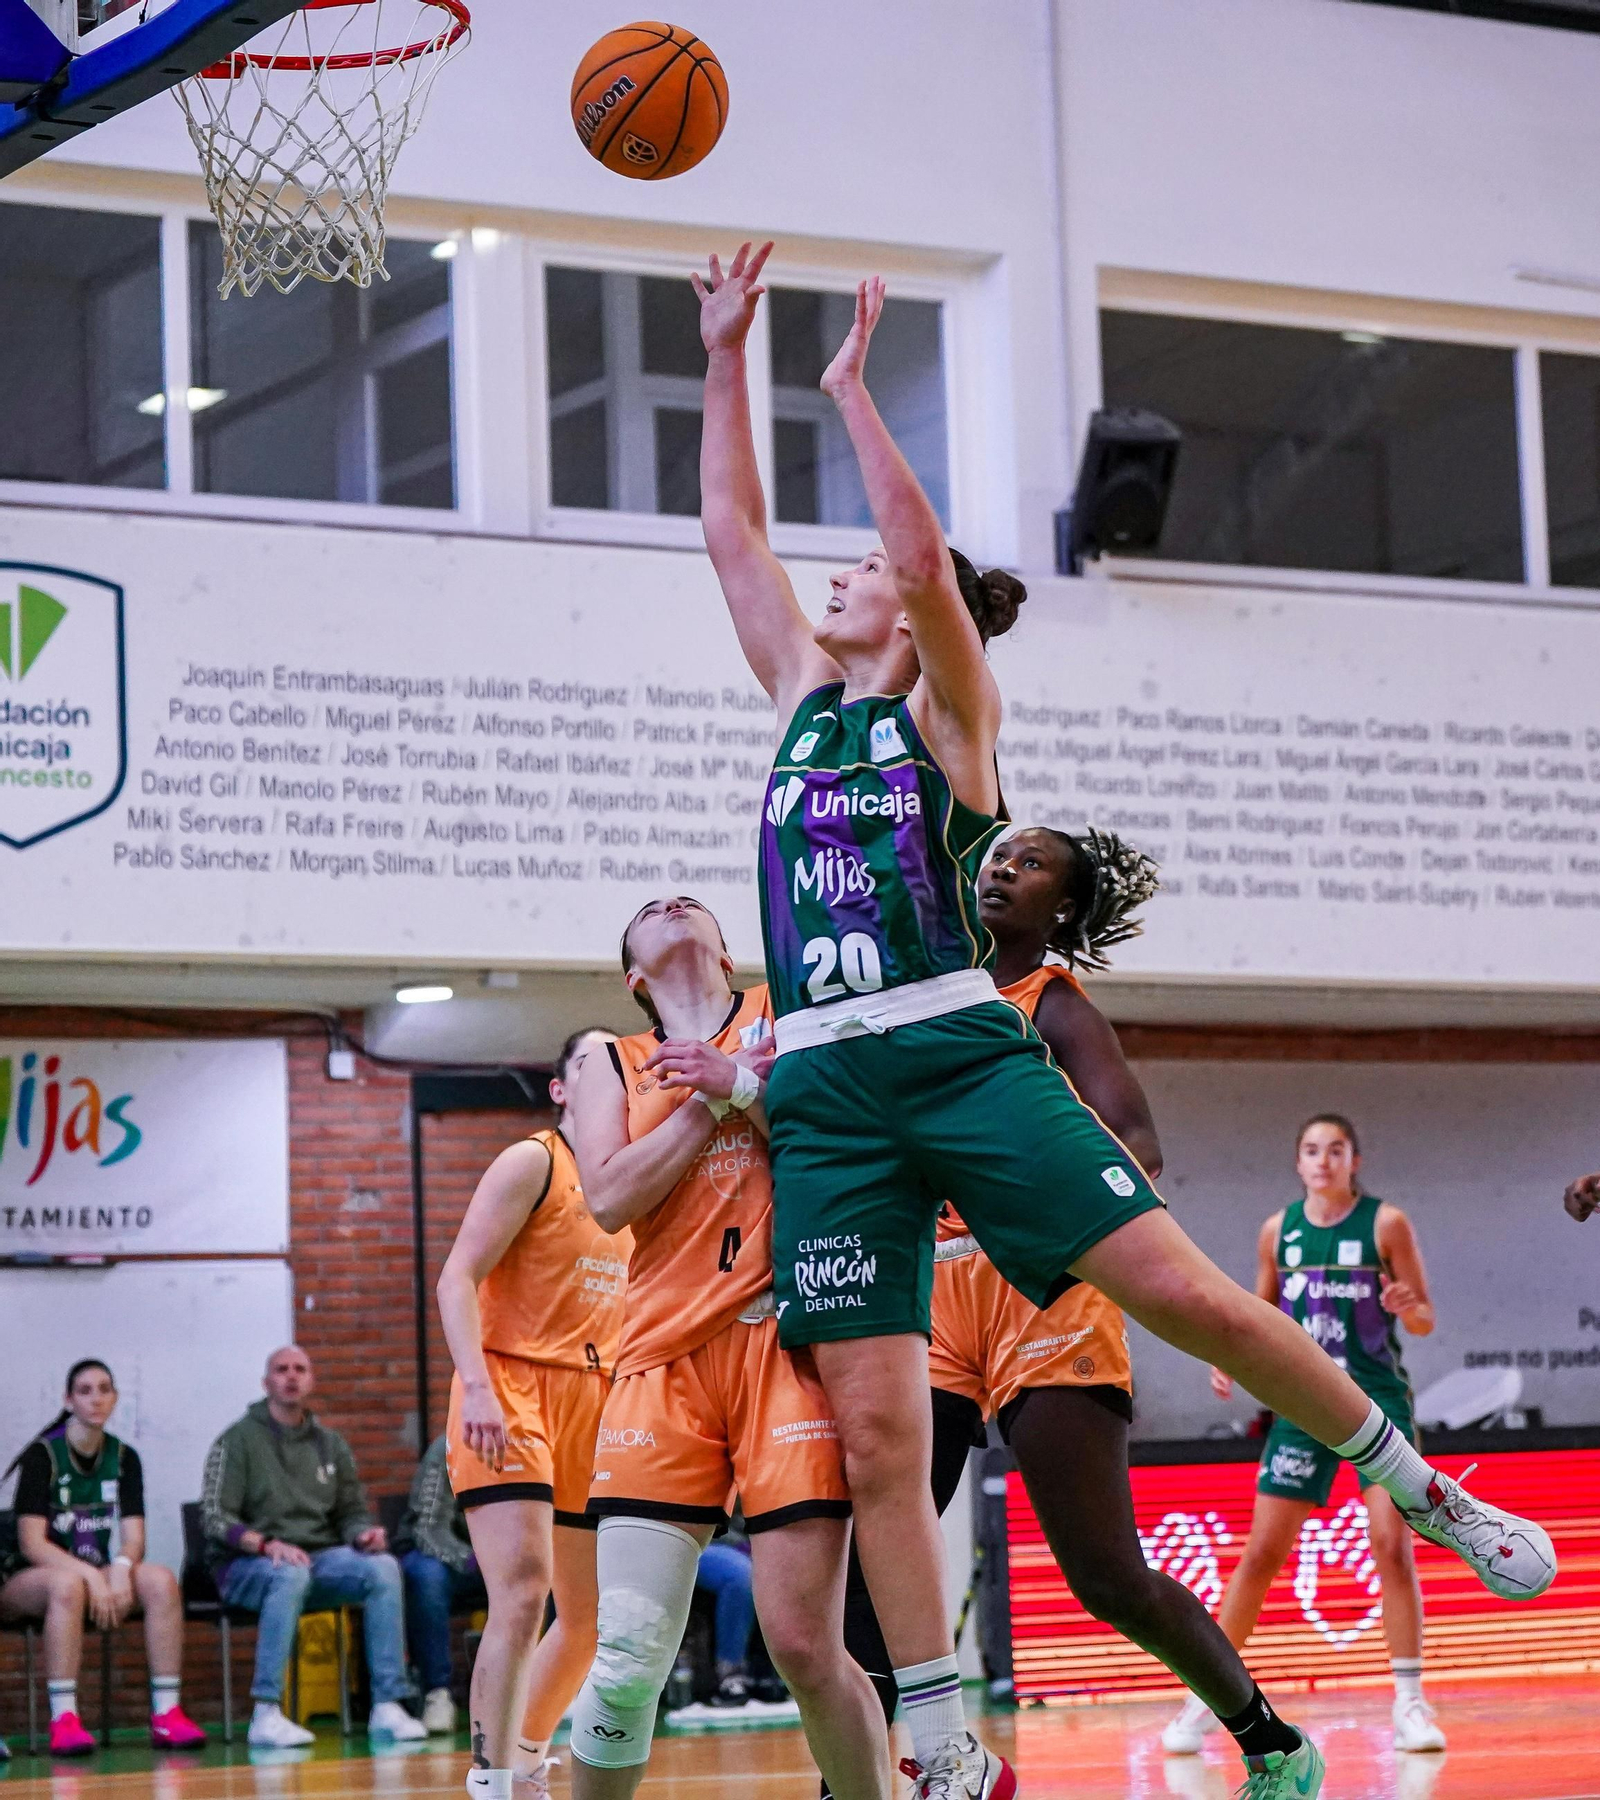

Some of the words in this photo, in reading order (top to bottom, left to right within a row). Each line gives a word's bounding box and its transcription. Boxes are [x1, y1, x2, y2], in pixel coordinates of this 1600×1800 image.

[182, 664, 265, 692] Joaquín
[273, 666, 444, 699] Entrambasaguas
[463, 676, 520, 699] Julián
[528, 678, 627, 709] Rodríguez
[645, 685, 714, 708] Manolo
[169, 698, 221, 725] Paco
[229, 701, 305, 727] Cabello
[325, 706, 390, 736] Miguel
[397, 708, 456, 735] Pérez
[472, 713, 544, 739] Alfonso
[551, 716, 616, 742] Portillo
[634, 719, 696, 745] Patrick
[0, 732, 71, 765] icaja
[154, 736, 234, 762] Antonio
[243, 737, 321, 766] Benítez
[341, 742, 388, 768] José
[394, 744, 477, 771] Torrubia
[495, 747, 559, 774] Rafael
[650, 755, 693, 780] José
[140, 771, 202, 797] David
[210, 772, 237, 797] Gil
[259, 776, 334, 801] Manolo
[342, 776, 401, 804] Pérez
[422, 779, 486, 807] Rubén
[494, 782, 549, 813] Mayo
[567, 786, 658, 814] Alejandro
[664, 789, 706, 814] Alba
[811, 786, 921, 823] Unicaja
[127, 807, 170, 831] Miki
[179, 809, 262, 836] Servera
[286, 813, 334, 838] Rafa
[343, 814, 403, 841] Freire
[423, 818, 507, 848] Augusto
[515, 821, 564, 845] Lima
[583, 821, 640, 848] Pablo
[646, 823, 730, 850] Almazán
[114, 842, 172, 868] Pablo
[180, 844, 270, 872] Sánchez
[290, 848, 366, 878] Morgan
[372, 851, 434, 876] Stilma
[453, 853, 511, 880] Lucas
[517, 855, 582, 881] Muñoz
[600, 857, 661, 883] Rubén
[668, 859, 752, 886] Guerrero
[793, 847, 877, 906] Mijas
[802, 932, 883, 1004] 20
[798, 1234, 862, 1253] CLINICAS
[584, 1274, 617, 1296] salud
[805, 1294, 866, 1312] DENTAL
[1308, 1281, 1371, 1302] Unicaja
[772, 1420, 829, 1438] RESTAURANTE
